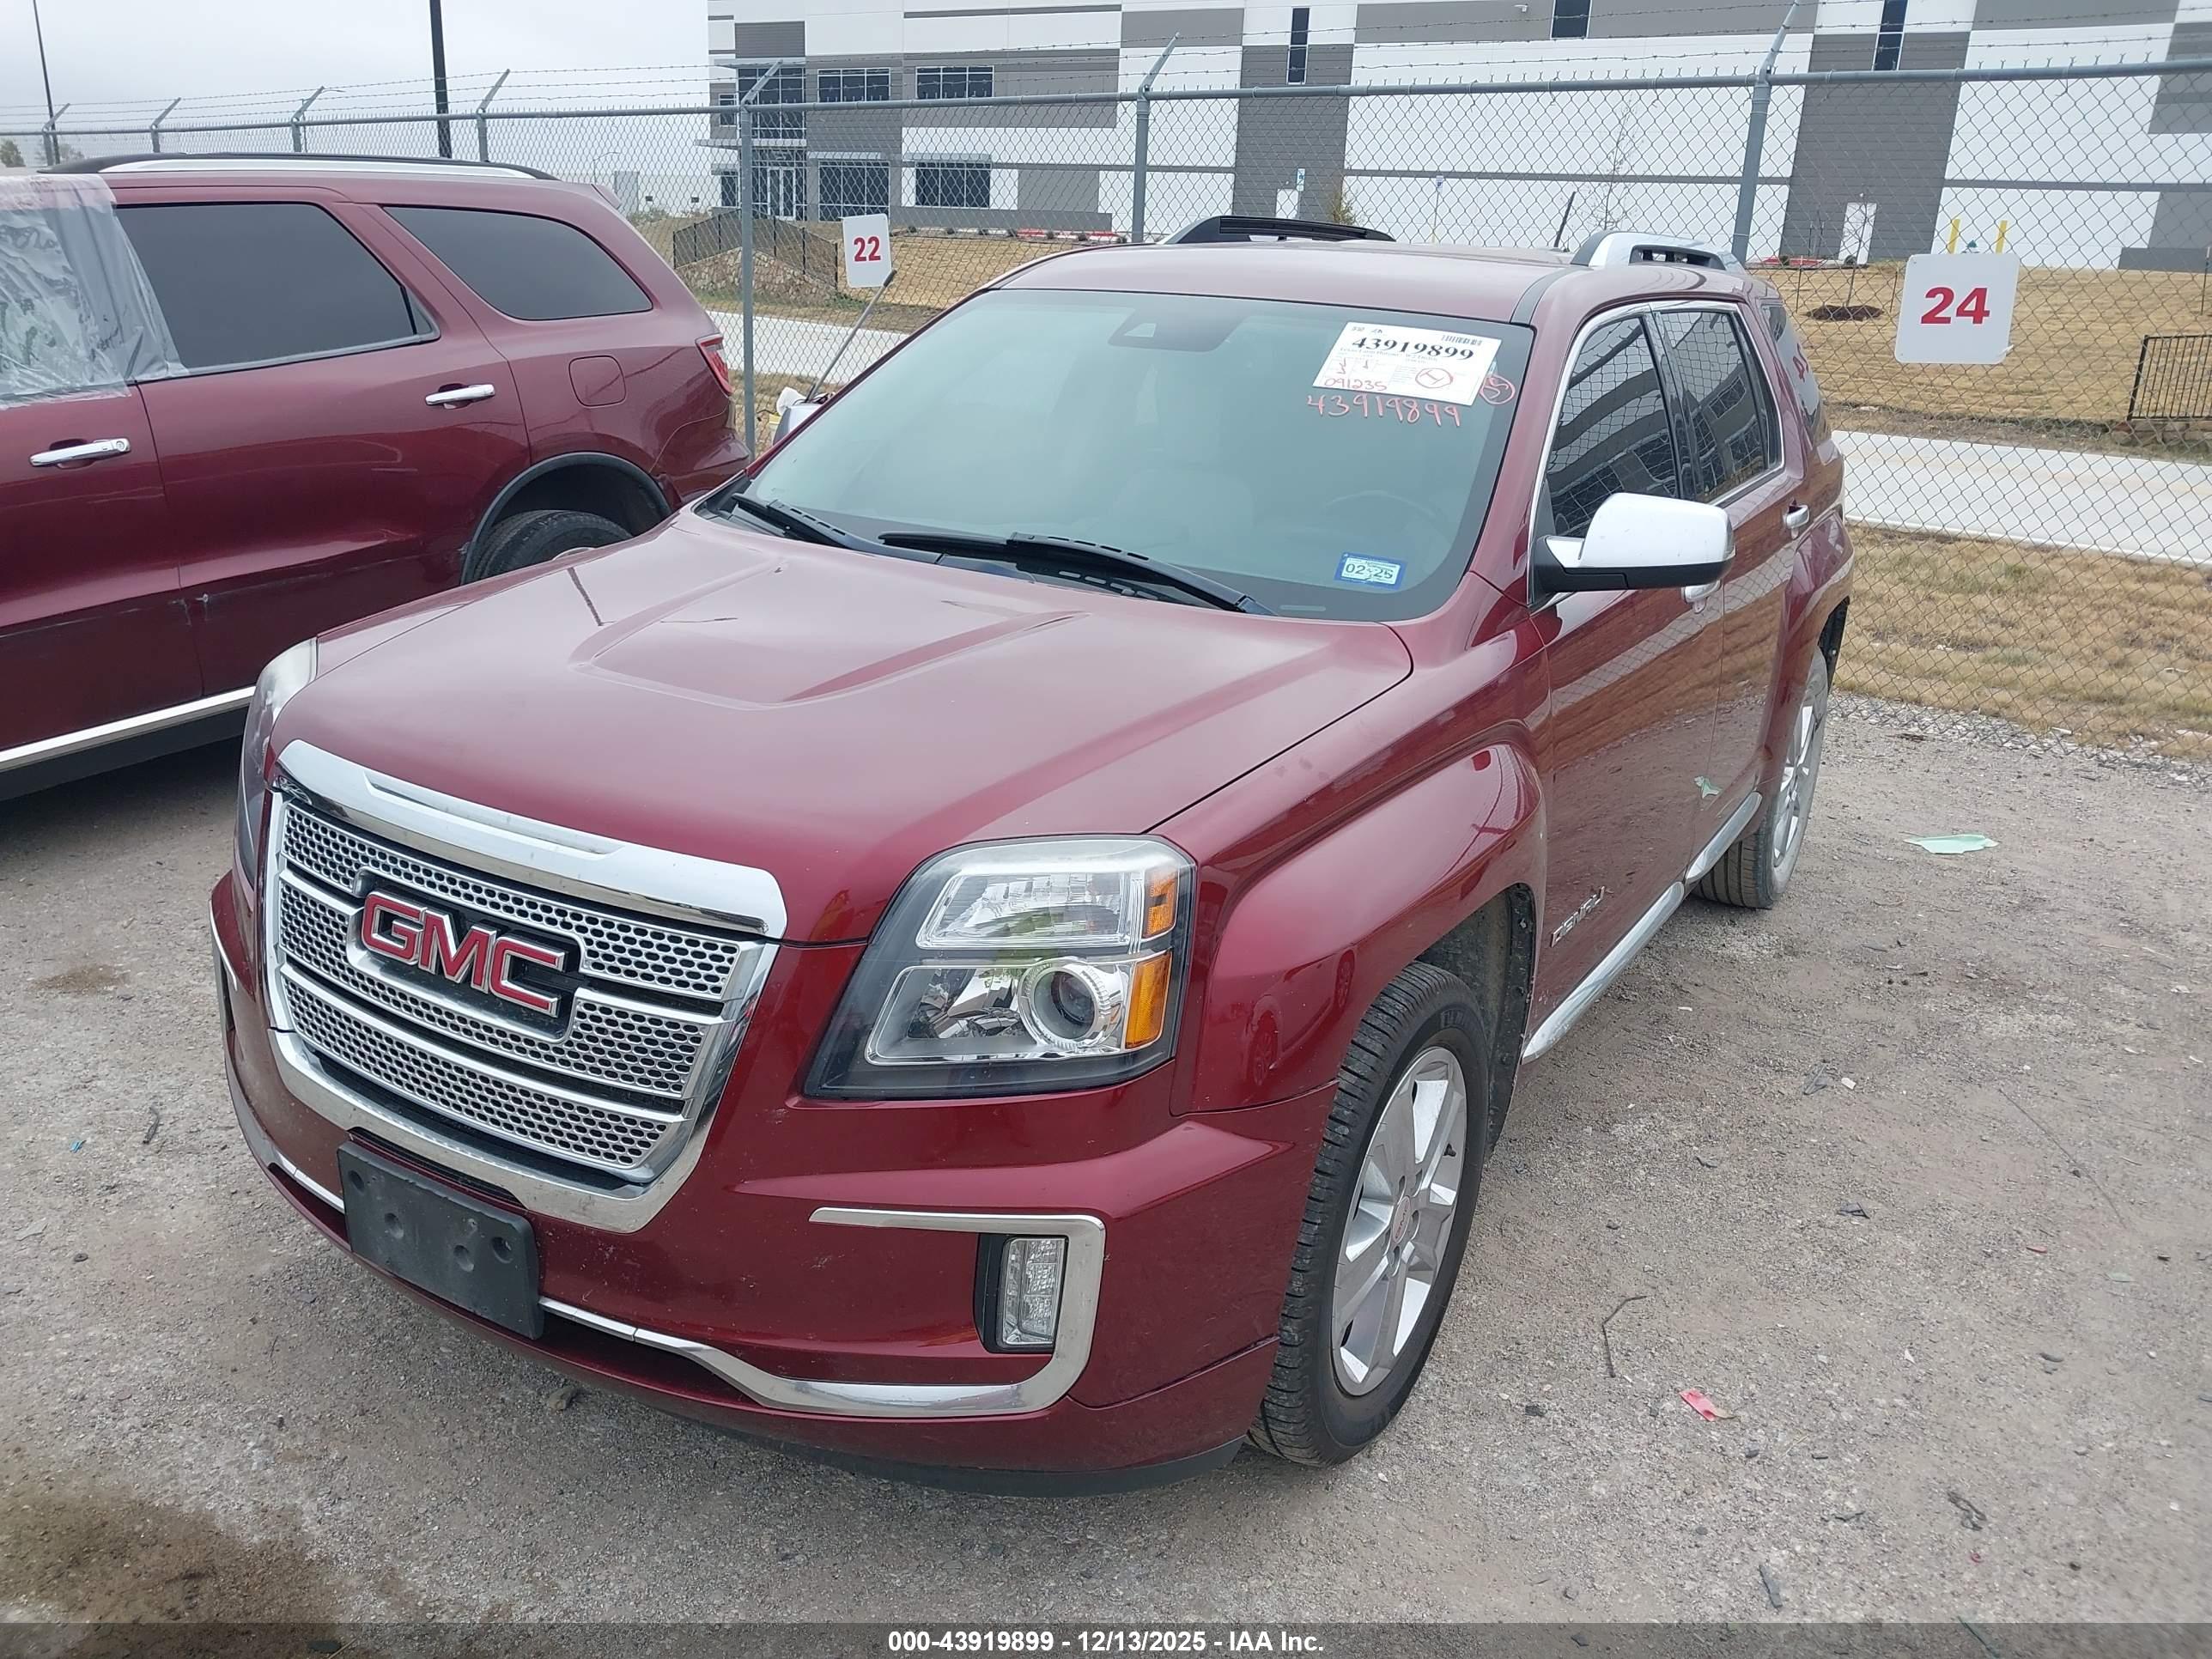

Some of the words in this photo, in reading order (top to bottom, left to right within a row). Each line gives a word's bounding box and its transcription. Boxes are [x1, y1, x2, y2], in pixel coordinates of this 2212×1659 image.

[854, 236, 881, 262] 22
[1920, 287, 1990, 325] 24
[1352, 337, 1474, 361] 43919899
[1346, 563, 1366, 574] 02
[361, 891, 567, 1018] GMC
